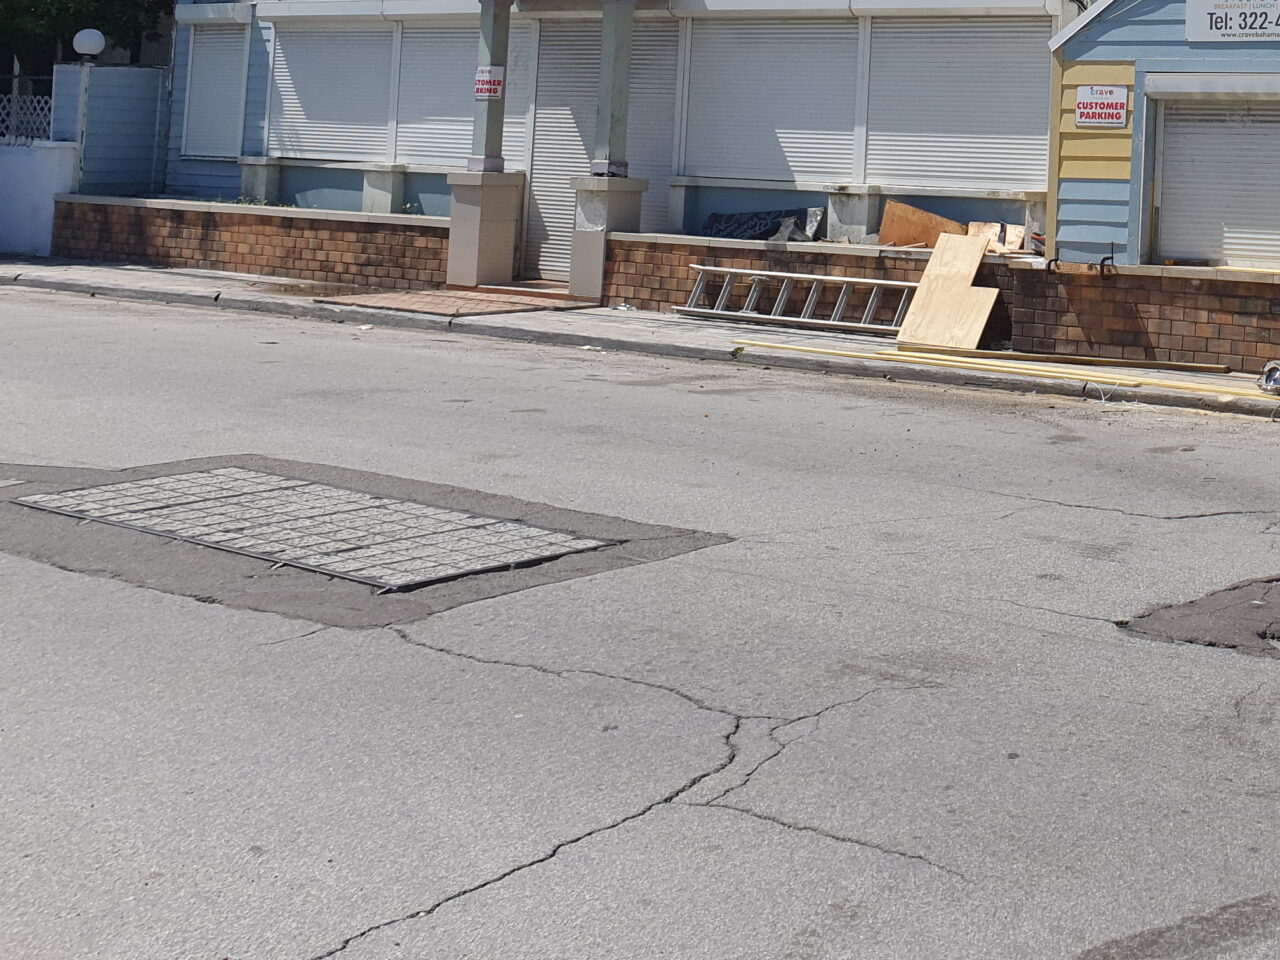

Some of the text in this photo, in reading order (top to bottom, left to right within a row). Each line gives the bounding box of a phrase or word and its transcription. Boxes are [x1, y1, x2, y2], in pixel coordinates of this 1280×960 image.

[1207, 12, 1233, 31] Tel:
[1076, 101, 1125, 111] CUSTOMER
[1079, 111, 1122, 121] PARKING
